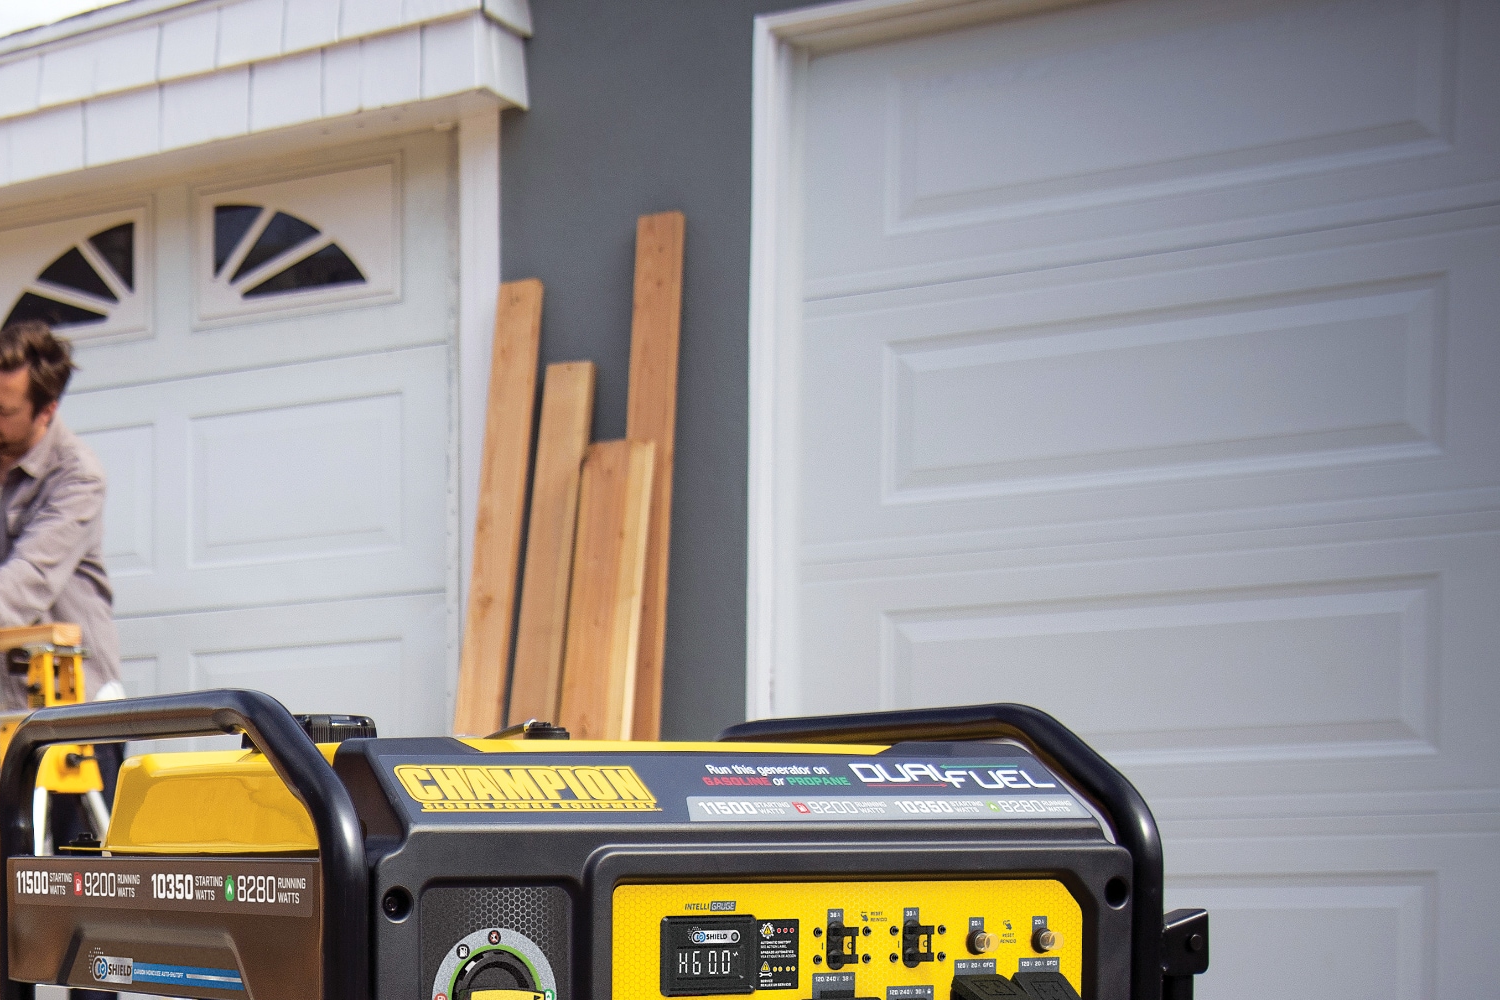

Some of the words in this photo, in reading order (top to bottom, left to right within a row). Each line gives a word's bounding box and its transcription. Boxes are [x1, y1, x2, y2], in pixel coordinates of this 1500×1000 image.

[705, 764, 732, 775] Run
[732, 764, 756, 775] this
[757, 765, 811, 777] generator
[812, 765, 830, 775] on
[395, 766, 656, 803] CHAMPION
[702, 776, 772, 787] GASOLINE
[772, 777, 785, 787] or
[786, 776, 851, 787] PROPANE
[423, 802, 487, 810] GLOBAL
[494, 802, 553, 810] POWER
[559, 802, 656, 810] EQUIPMENT
[698, 801, 758, 815] 11500
[809, 801, 859, 814] 9200
[894, 800, 953, 814] 10350
[998, 800, 1046, 813] 8280
[16, 870, 49, 895] 11500
[49, 872, 73, 883] STARTING
[84, 872, 116, 897] 9200
[117, 874, 141, 885] RUNNING
[151, 873, 194, 900] 10350
[195, 876, 223, 887] STARTING
[237, 875, 276, 903] 8280
[277, 877, 306, 889] RUNNING
[49, 885, 66, 895] WATTS
[117, 887, 136, 898] WATTS
[195, 889, 215, 901] WATTS
[278, 892, 300, 904] WATTS
[108, 963, 132, 977] SHIELD
